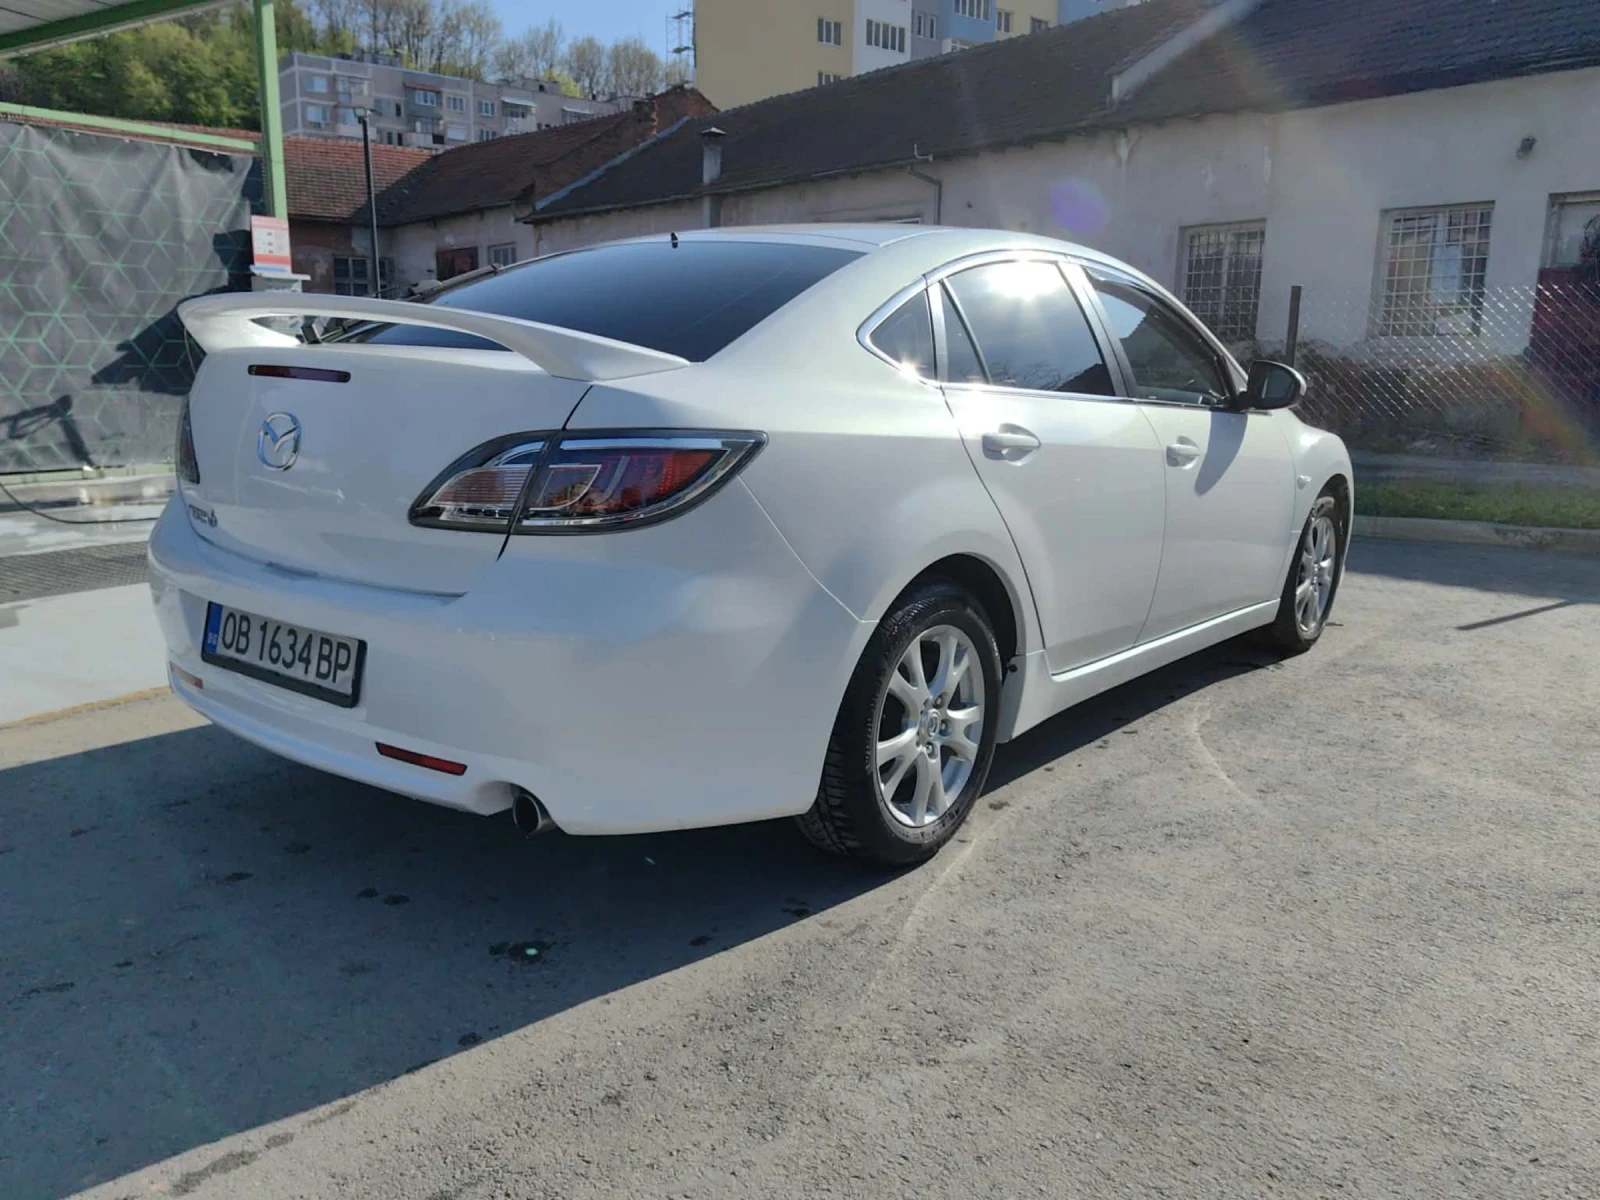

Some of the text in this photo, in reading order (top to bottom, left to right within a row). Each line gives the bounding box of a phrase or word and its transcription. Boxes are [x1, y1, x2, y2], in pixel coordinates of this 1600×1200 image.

[207, 631, 218, 645] BG
[222, 612, 352, 684] OB 1634 BP
